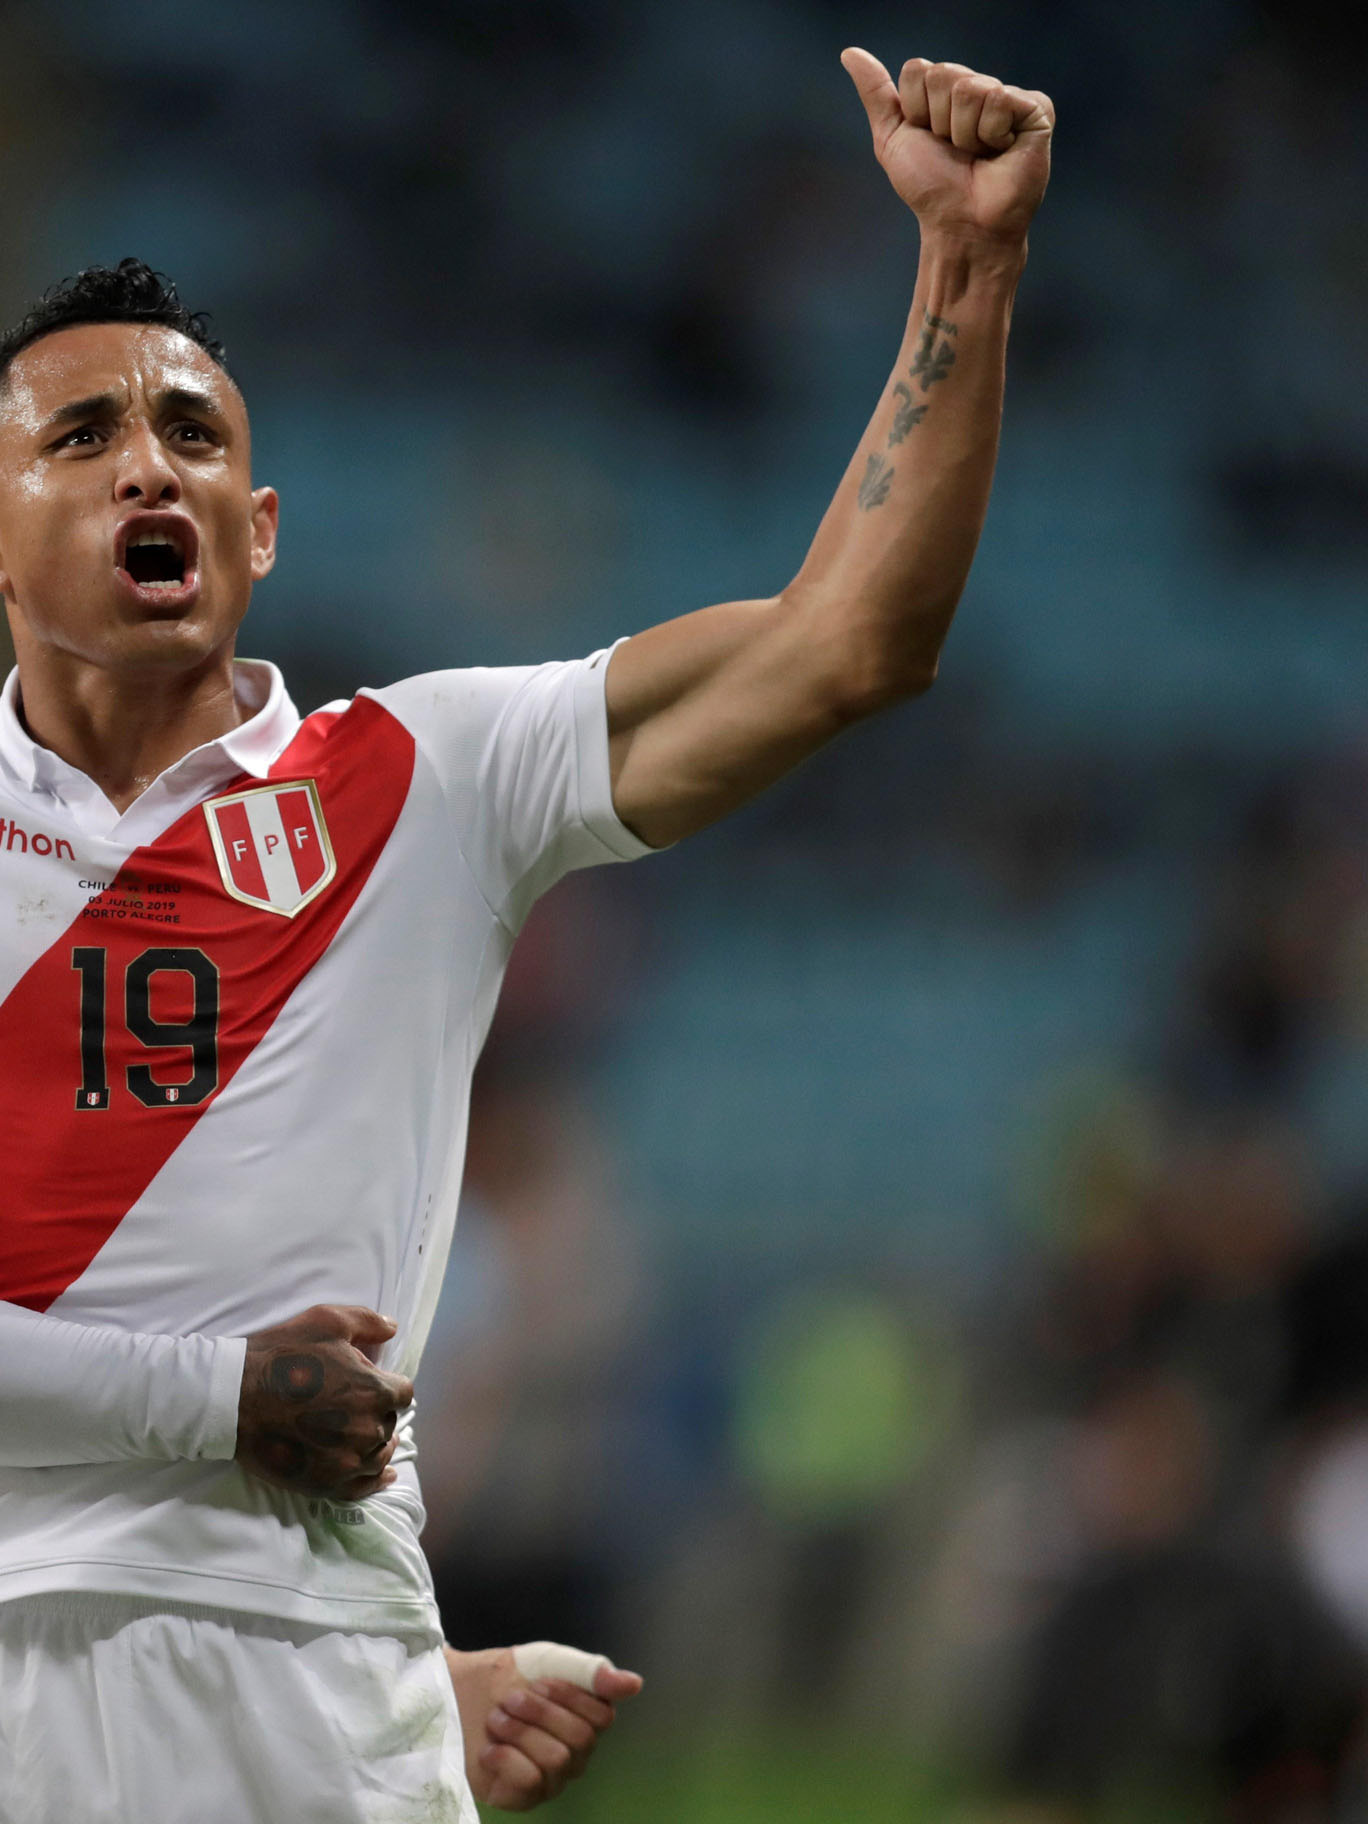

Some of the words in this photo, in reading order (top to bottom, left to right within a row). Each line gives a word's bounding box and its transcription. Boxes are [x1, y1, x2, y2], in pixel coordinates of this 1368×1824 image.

[78, 880, 118, 892] CHILE
[88, 895, 102, 904] 03
[107, 898, 144, 909] JULIO
[147, 901, 176, 910] 2019
[83, 908, 126, 919] PORTO
[130, 911, 181, 924] ALEGRE
[72, 947, 220, 1111] 19
